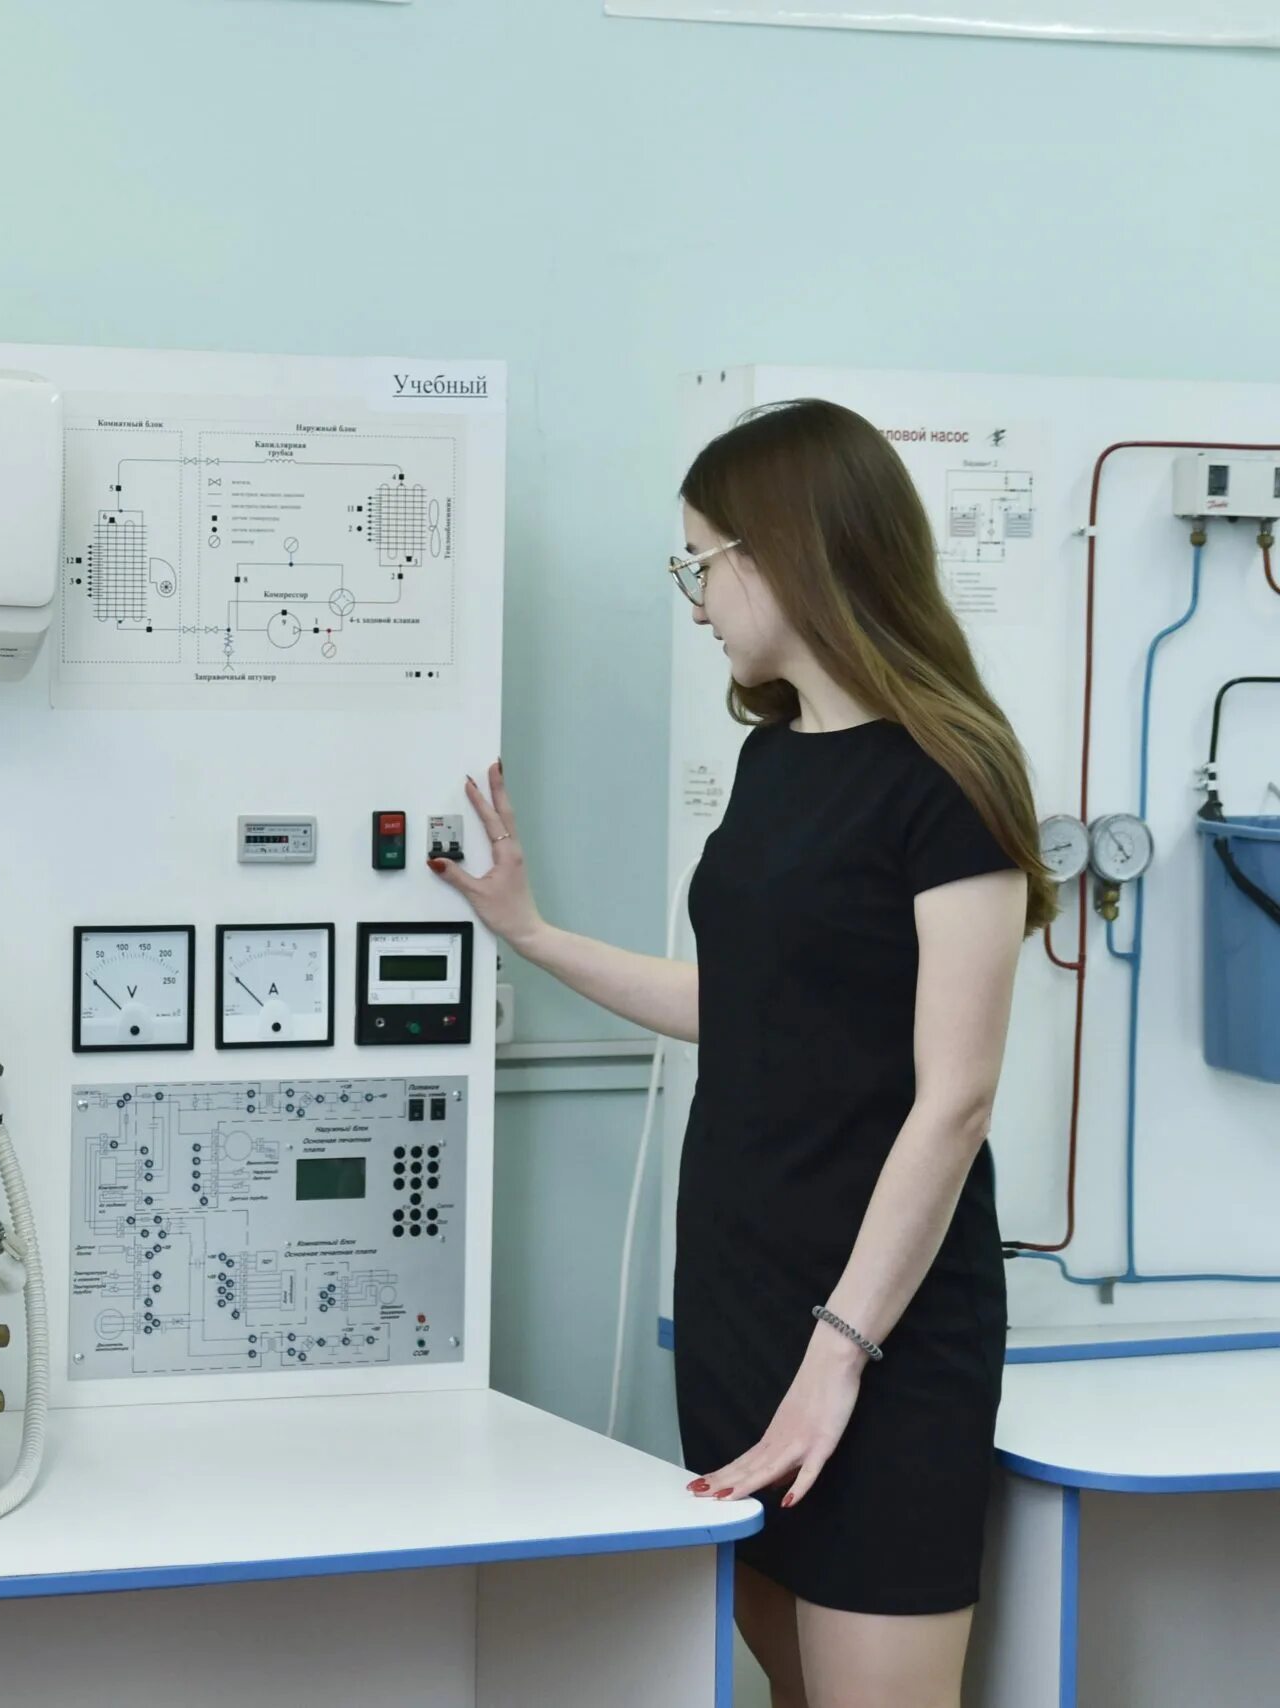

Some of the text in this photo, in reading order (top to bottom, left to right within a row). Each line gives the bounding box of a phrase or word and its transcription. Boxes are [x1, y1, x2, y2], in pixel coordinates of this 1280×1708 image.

[393, 374, 488, 395] Учебный
[98, 419, 143, 427] Комнатный
[296, 424, 337, 433] Наружный
[880, 427, 969, 443] ловой насос
[264, 591, 308, 599] Компрессор
[195, 673, 246, 682] Заправочный
[116, 943, 129, 951] 100
[139, 943, 152, 951] 150
[163, 977, 176, 985] 250
[127, 985, 138, 998] V
[269, 983, 279, 995] A
